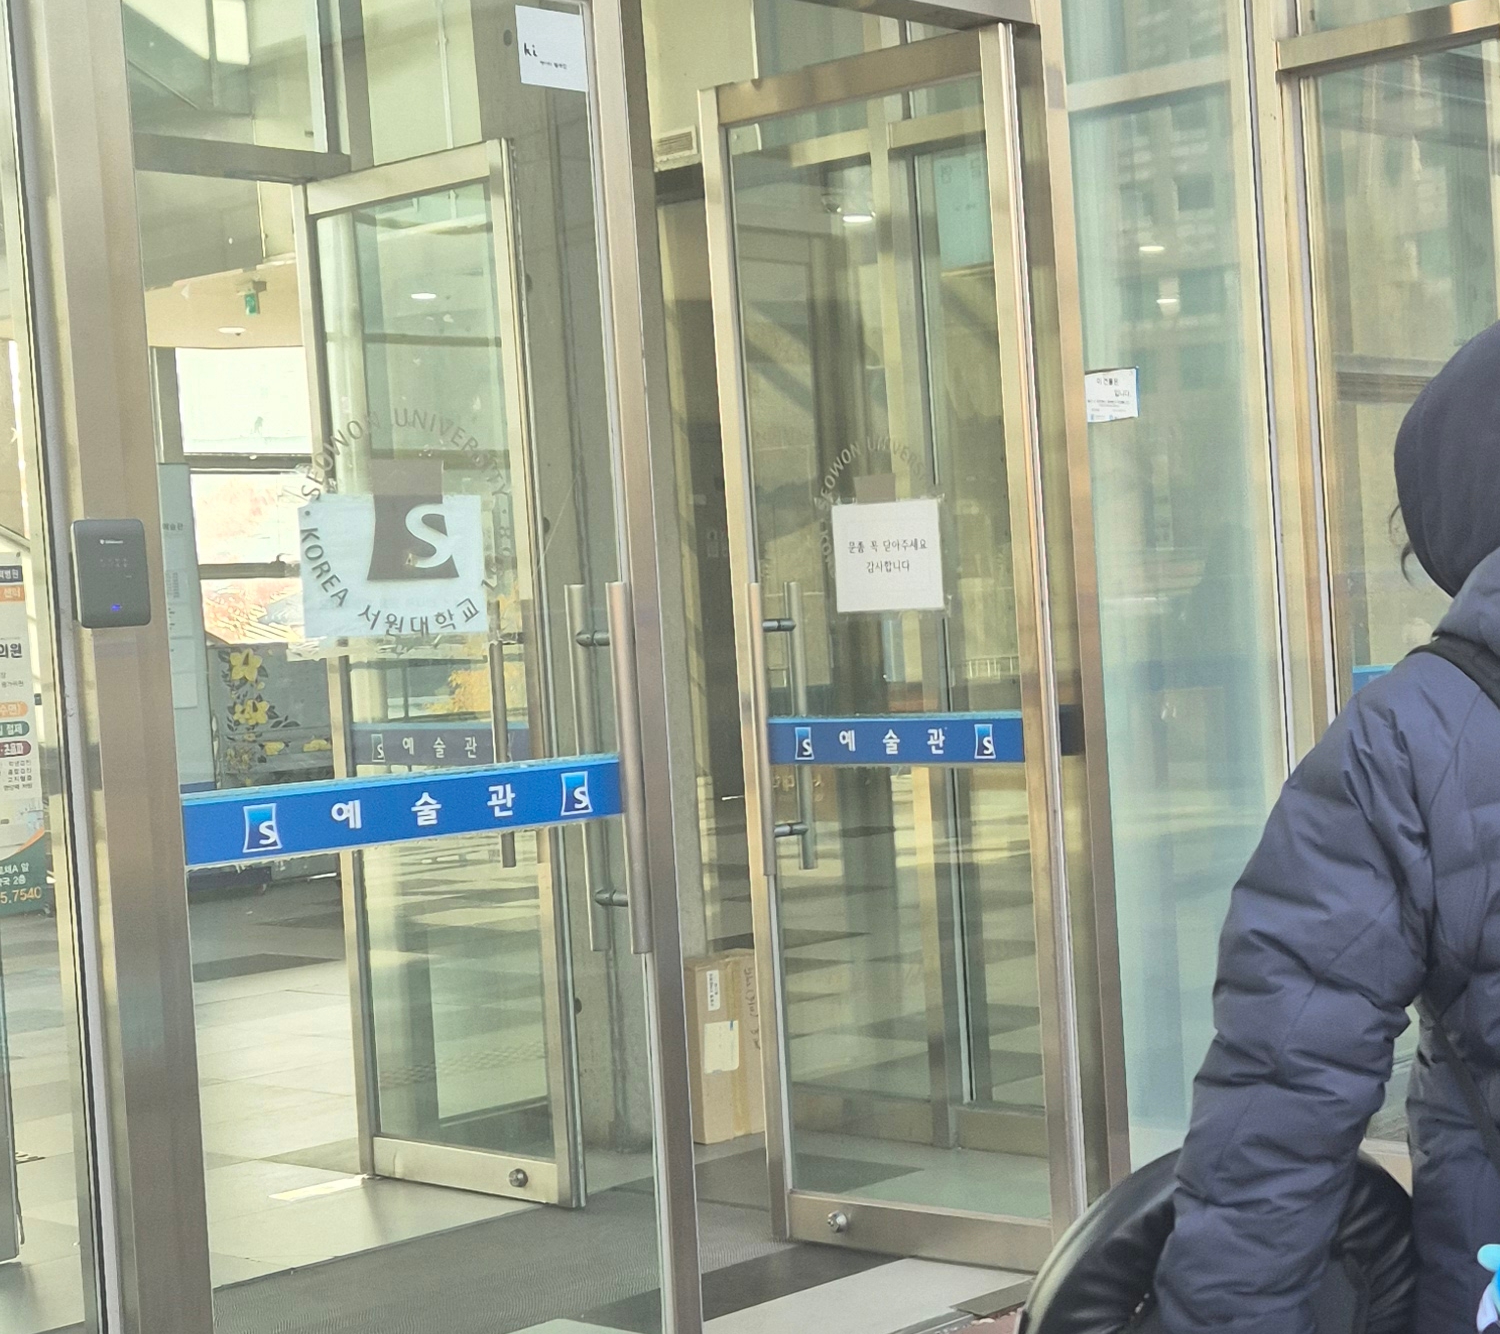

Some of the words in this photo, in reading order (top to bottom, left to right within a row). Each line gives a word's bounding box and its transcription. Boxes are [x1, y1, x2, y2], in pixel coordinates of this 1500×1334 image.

[883, 538, 928, 552] 닫아주세요
[300, 526, 350, 607] KOREA
[866, 559, 911, 574] 감사합니다
[357, 598, 480, 637] 서원대학교
